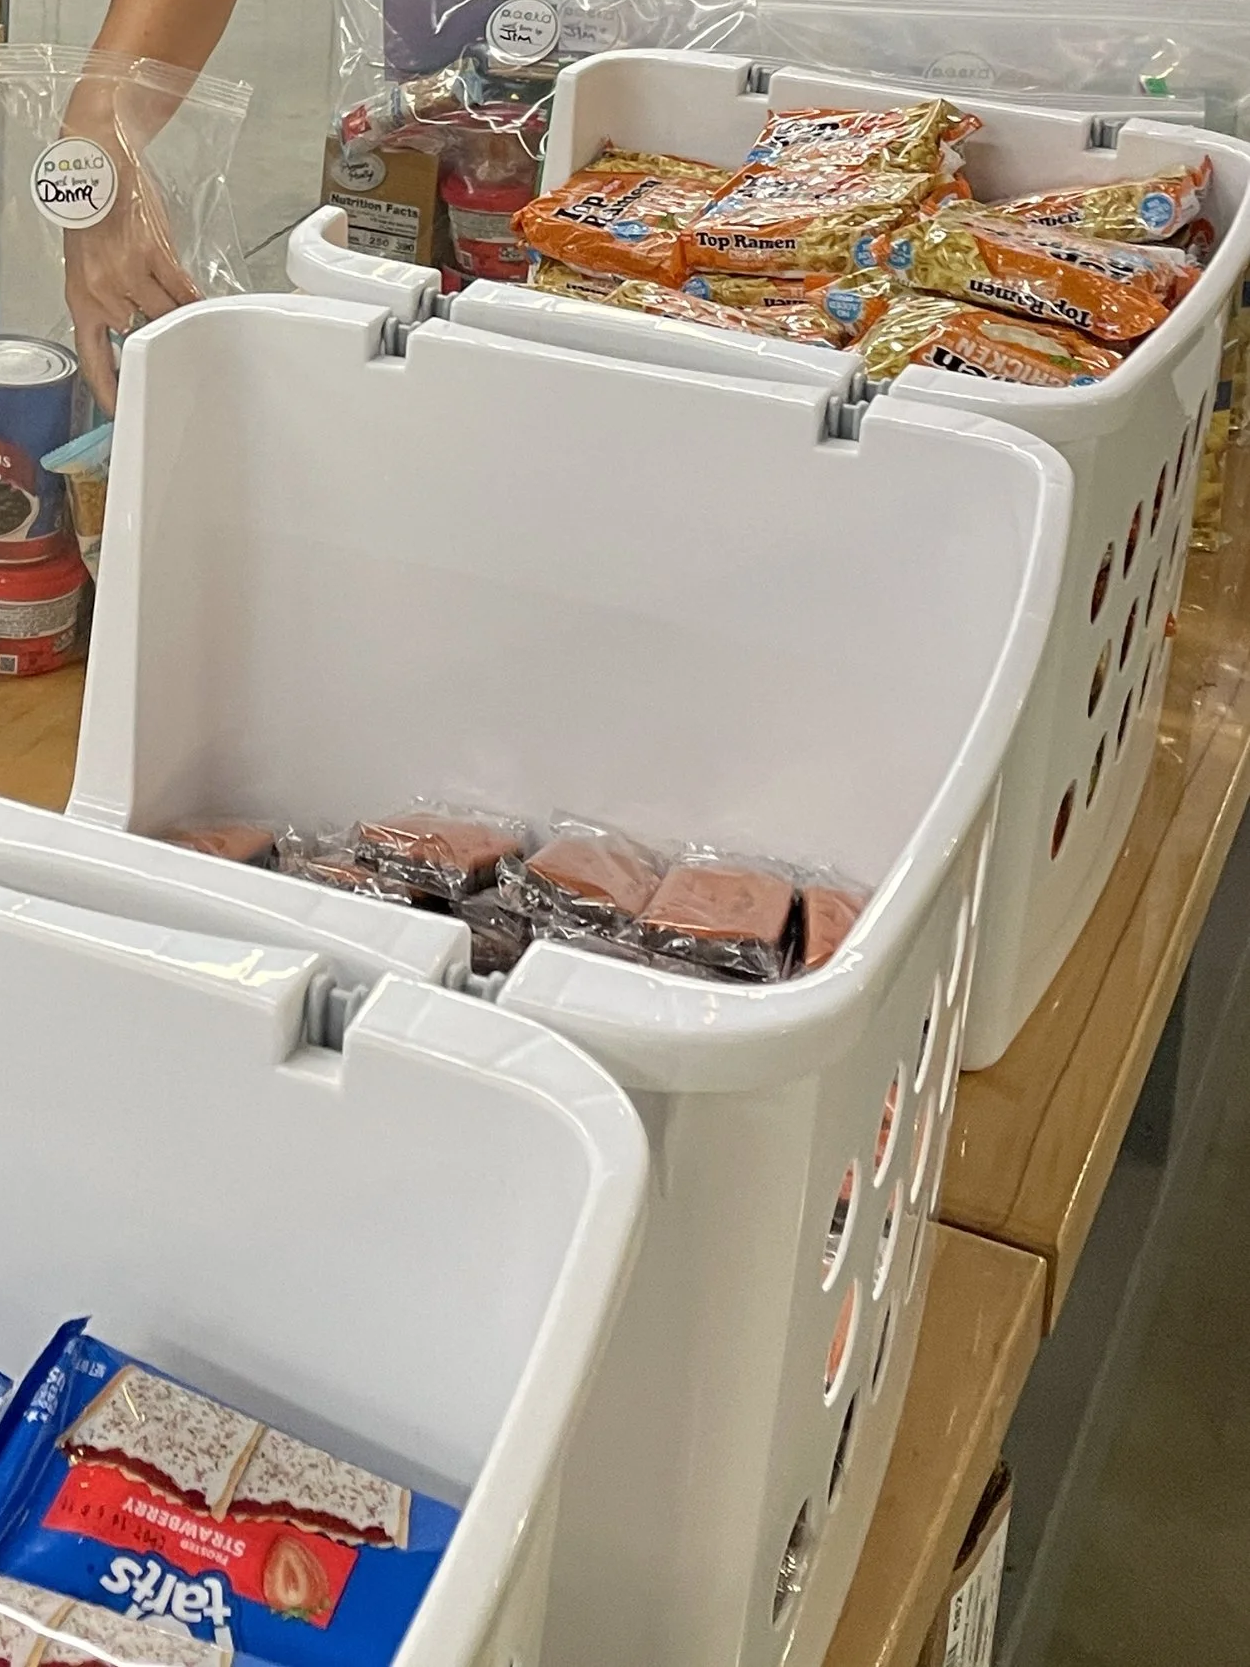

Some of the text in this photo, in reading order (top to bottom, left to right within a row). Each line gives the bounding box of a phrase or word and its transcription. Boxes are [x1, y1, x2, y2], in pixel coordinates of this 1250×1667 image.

[36, 179, 99, 211] Donna
[330, 193, 419, 218] Nutrition Facts
[368, 236, 390, 247] 250
[695, 231, 796, 252] Top Ramen
[968, 278, 1094, 331] Top Ramen
[121, 1496, 248, 1559] STRAWBERRY
[98, 1555, 232, 1626] tarts
